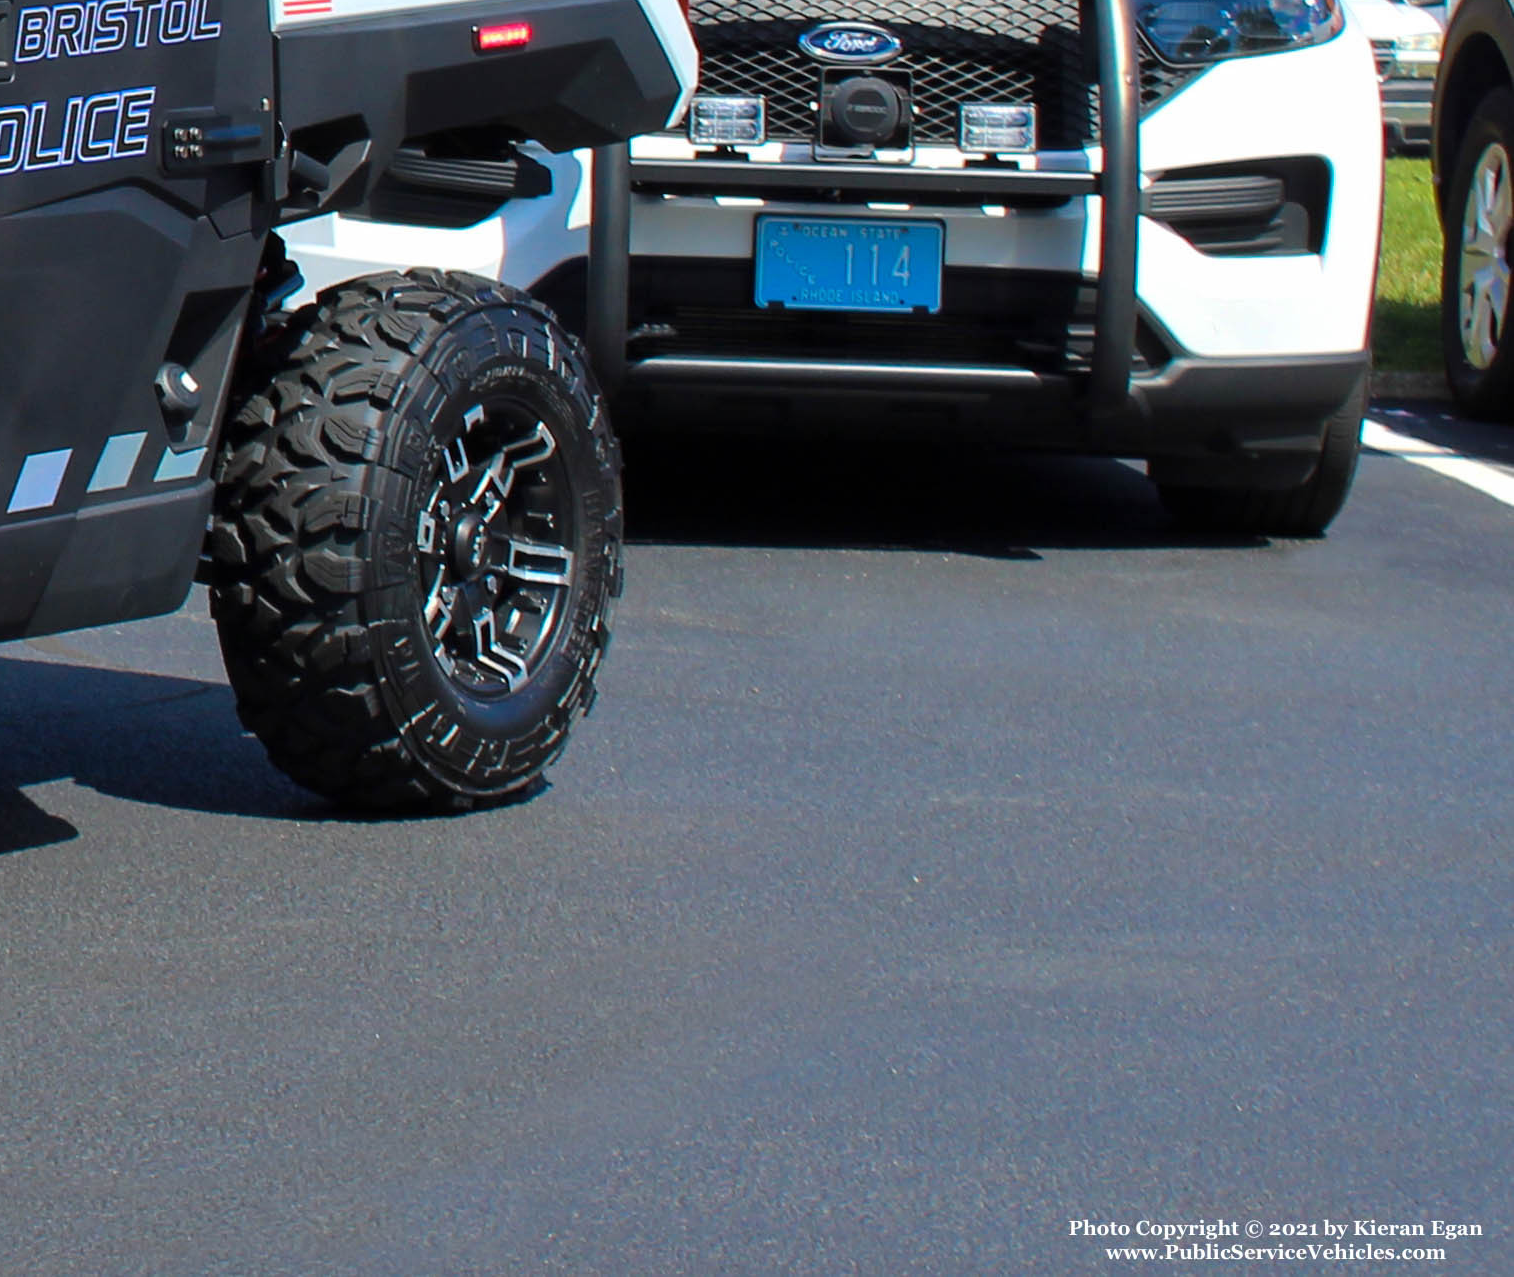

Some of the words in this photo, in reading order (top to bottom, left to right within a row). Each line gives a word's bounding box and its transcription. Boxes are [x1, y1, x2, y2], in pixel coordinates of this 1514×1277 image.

[824, 31, 877, 52] Ford
[802, 227, 848, 237] OCEAN
[860, 228, 902, 240] STATE
[770, 240, 817, 285] POLICE
[846, 243, 910, 287] 114
[800, 288, 842, 303] RHODE
[851, 290, 900, 305] ISLAND
